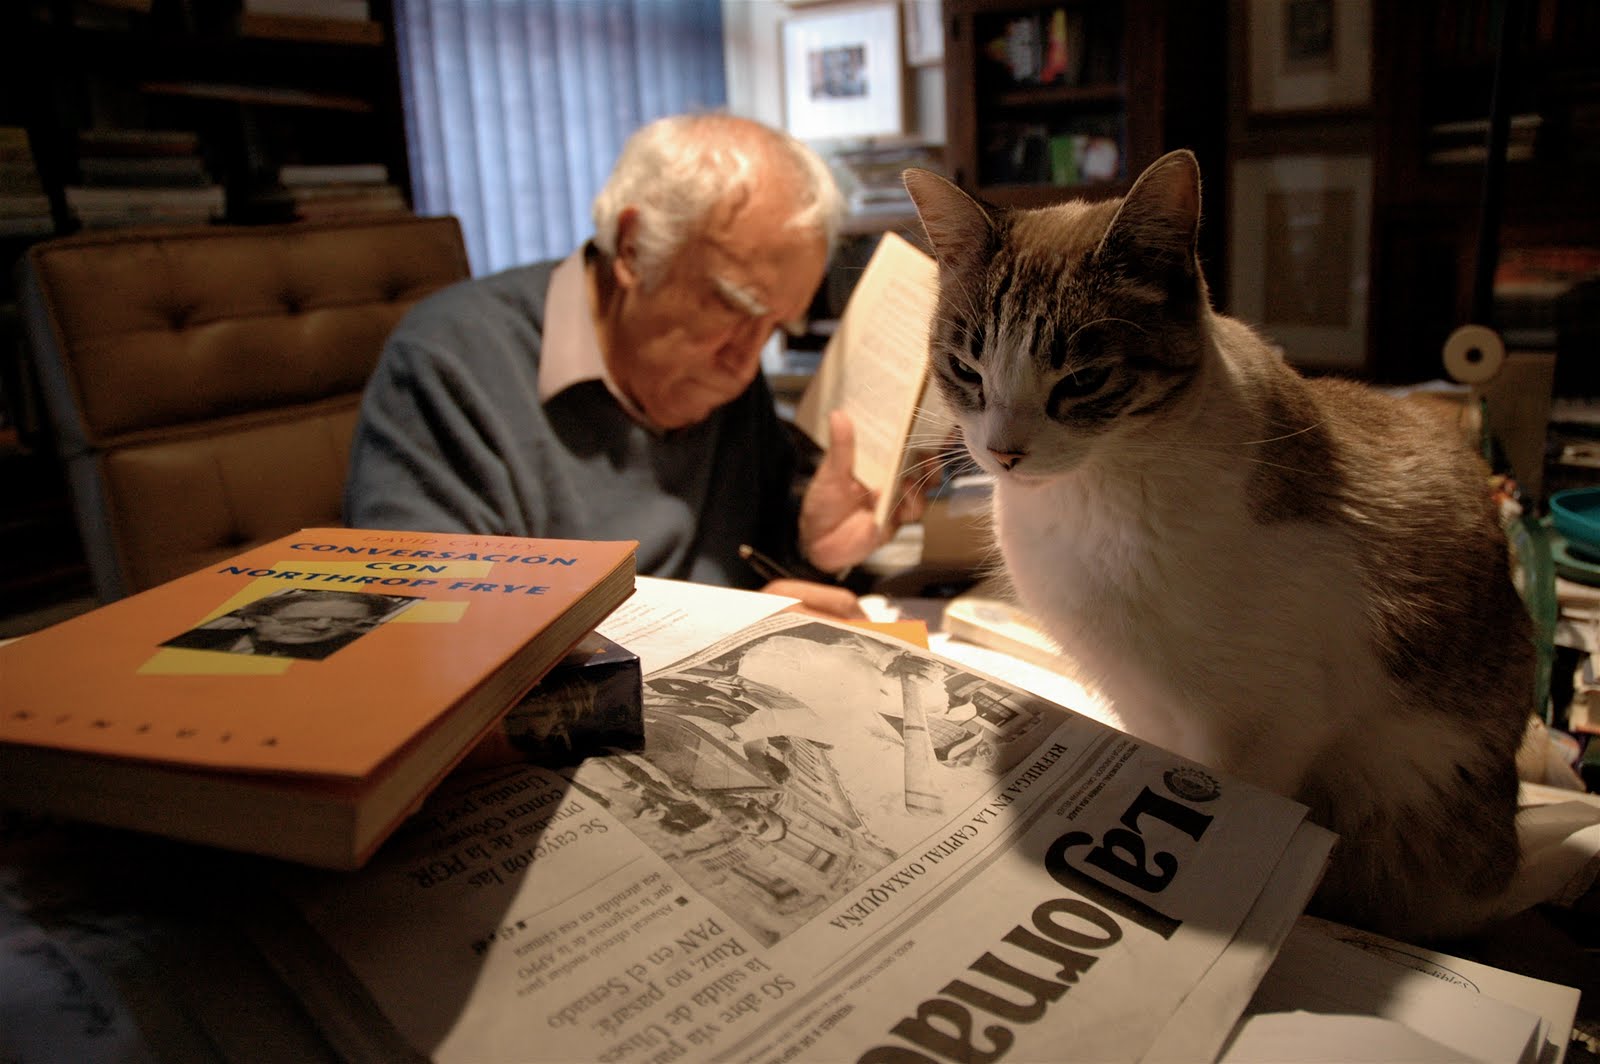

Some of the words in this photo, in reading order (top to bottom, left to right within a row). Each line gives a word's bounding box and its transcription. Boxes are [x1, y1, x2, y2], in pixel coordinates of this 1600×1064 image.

[362, 535, 439, 546] DAVID
[289, 542, 578, 566] CONVERSACIÓN
[365, 561, 448, 574] CON
[217, 566, 439, 588] NORTHROP
[447, 580, 551, 595] FRYE
[1006, 743, 1067, 795] REFRIEGA
[504, 788, 563, 820] contra
[990, 791, 1014, 812] EN
[514, 800, 585, 836] pruebas
[579, 818, 608, 835] Se
[971, 806, 996, 827] LA
[489, 832, 515, 849] de
[919, 823, 978, 867] CAPITAL
[1082, 785, 1214, 889] La
[463, 843, 492, 860] la
[500, 830, 578, 874] cayeron
[413, 854, 467, 890] PGR
[466, 867, 505, 889] las
[641, 871, 660, 885] sea
[594, 883, 640, 915] atendida
[653, 885, 673, 898] que
[828, 861, 926, 931] OAXAQUEÑA
[674, 917, 724, 954] PAN
[645, 945, 675, 965] en
[743, 956, 770, 971] la
[624, 963, 647, 982] el
[664, 968, 693, 988] no
[690, 968, 746, 1006] salida
[759, 973, 796, 1001] SG
[546, 977, 630, 1029] Senado
[664, 1004, 692, 1025] de
[717, 993, 761, 1025] abre
